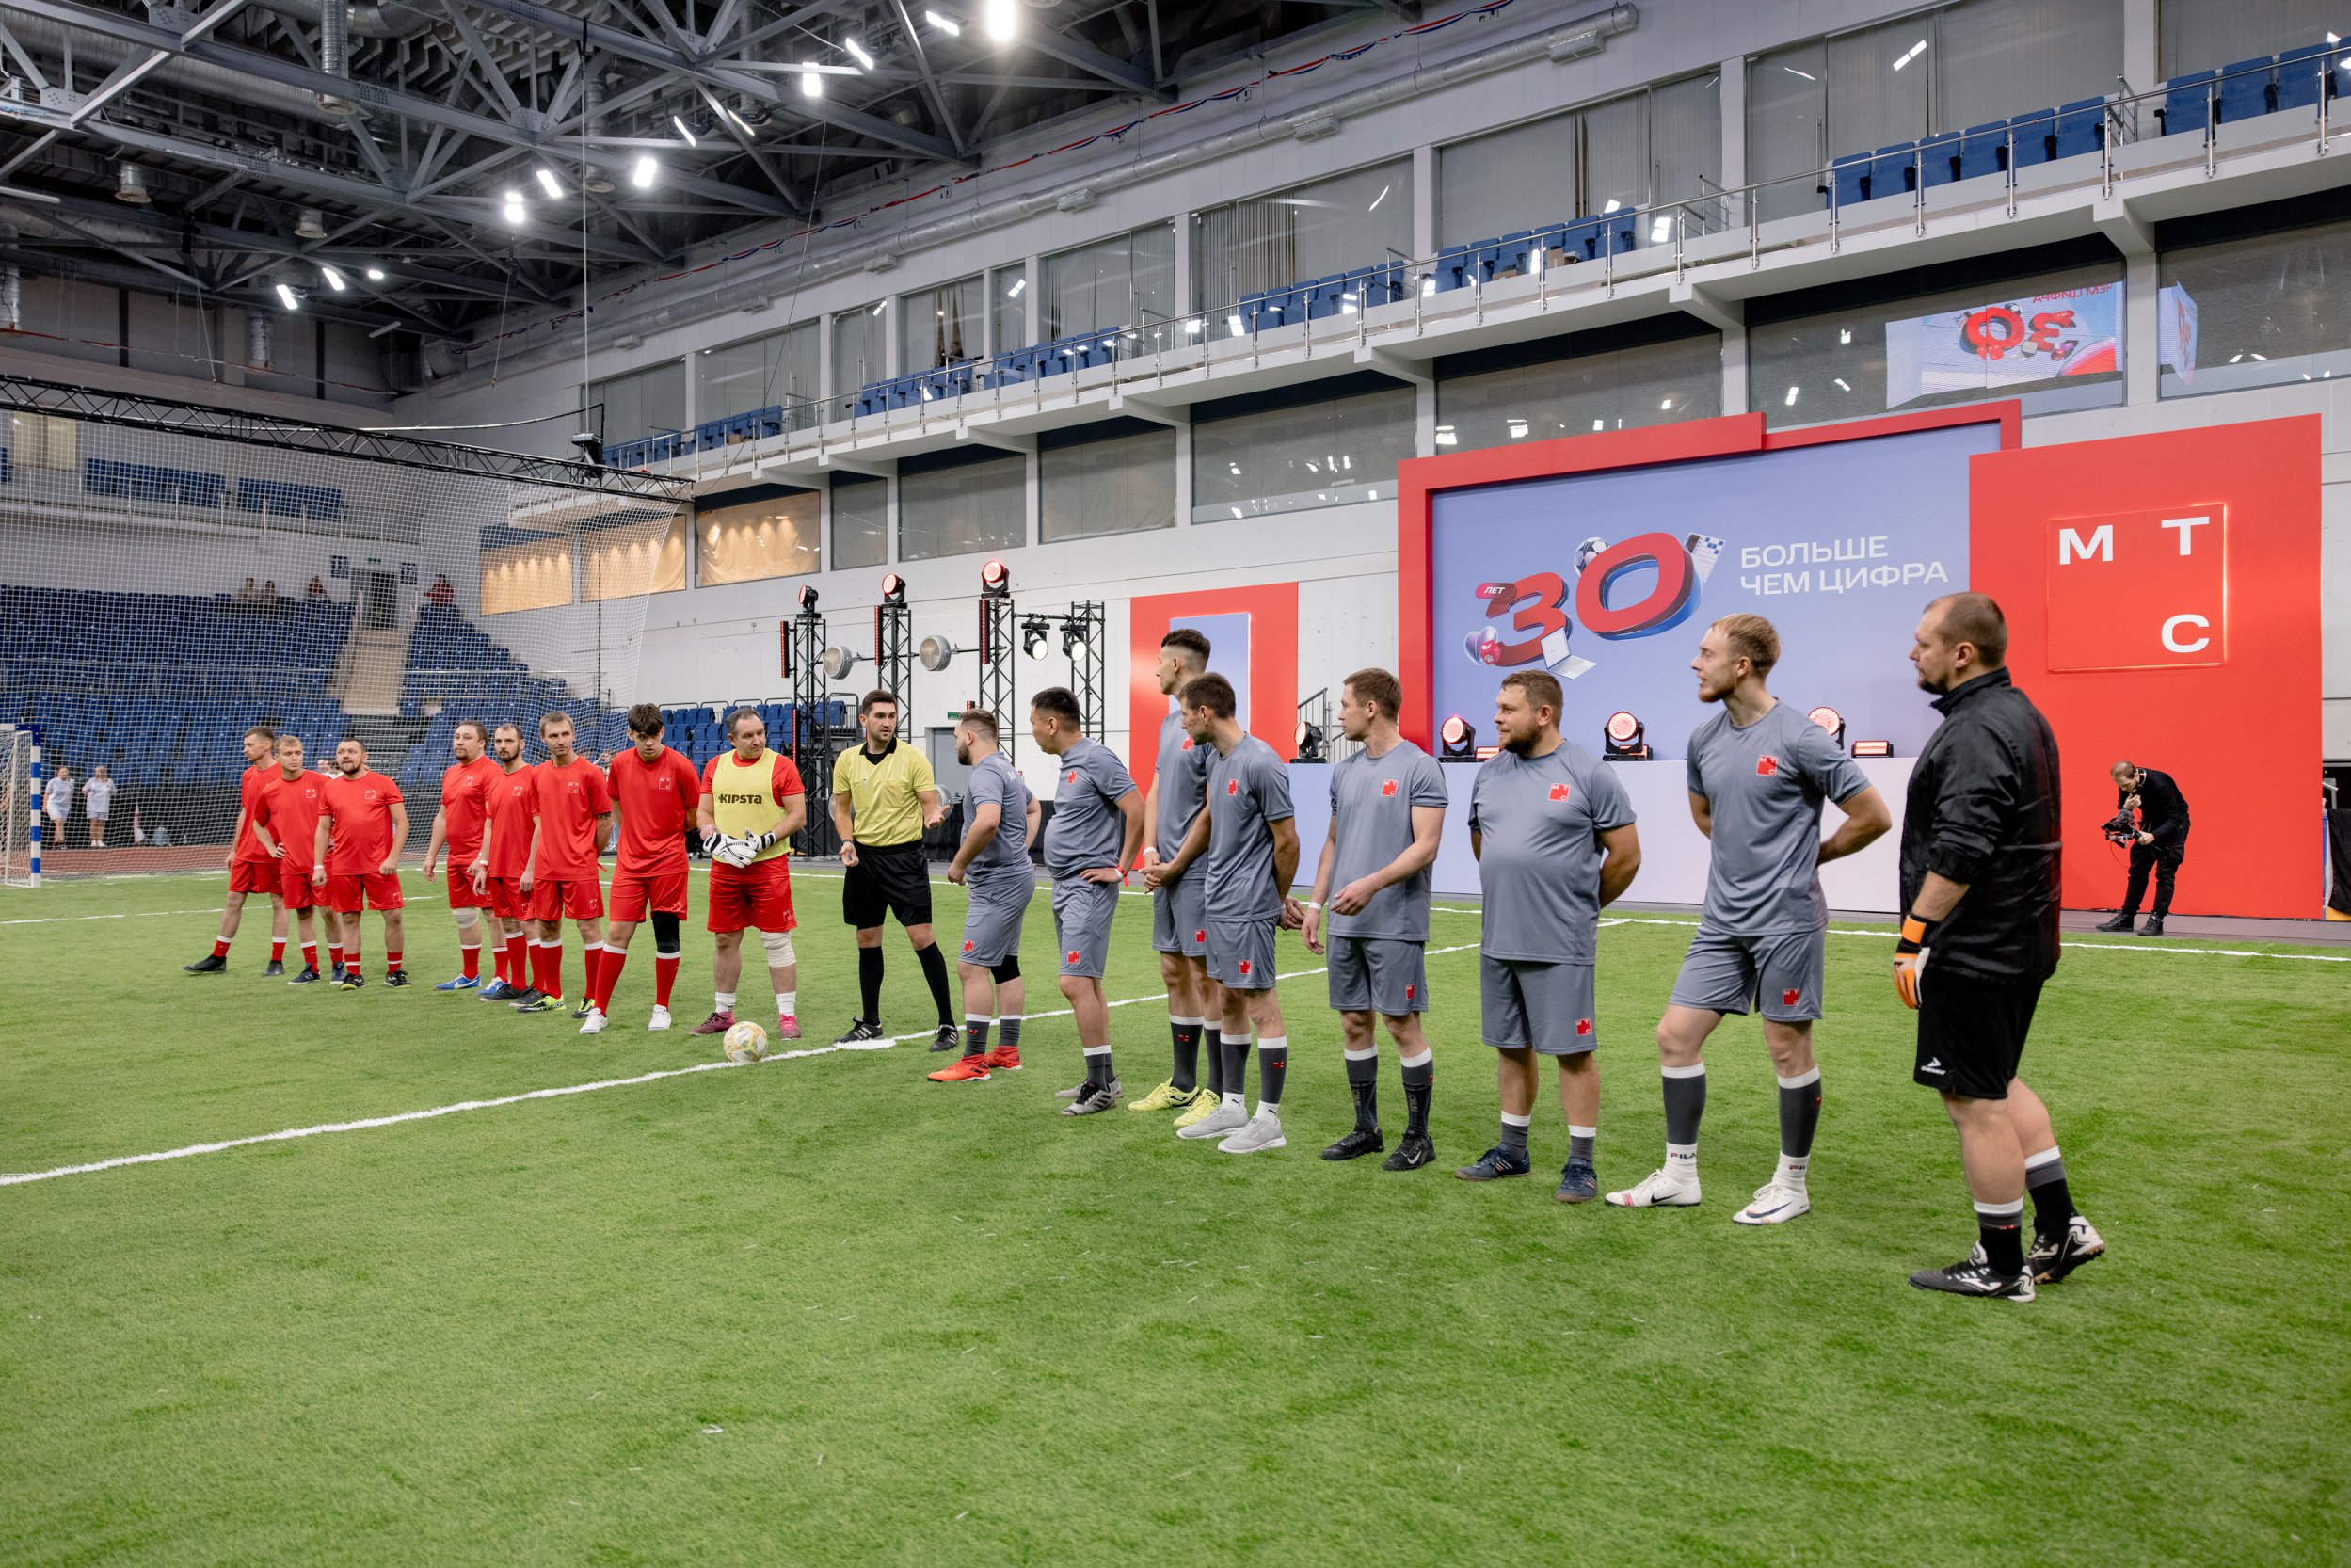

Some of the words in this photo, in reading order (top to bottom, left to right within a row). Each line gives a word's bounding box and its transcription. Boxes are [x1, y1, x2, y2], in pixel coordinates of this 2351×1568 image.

[1741, 536, 1889, 568] БОЛЬШЕ
[1741, 571, 1810, 596] ЧЕМ
[1819, 561, 1949, 594] ЦИФРА
[1484, 585, 1505, 595] ЛЕТ
[1485, 532, 1703, 667] 30
[1760, 757, 1776, 775] МТС
[1384, 780, 1398, 796] МТС
[1552, 784, 1568, 801] МТС
